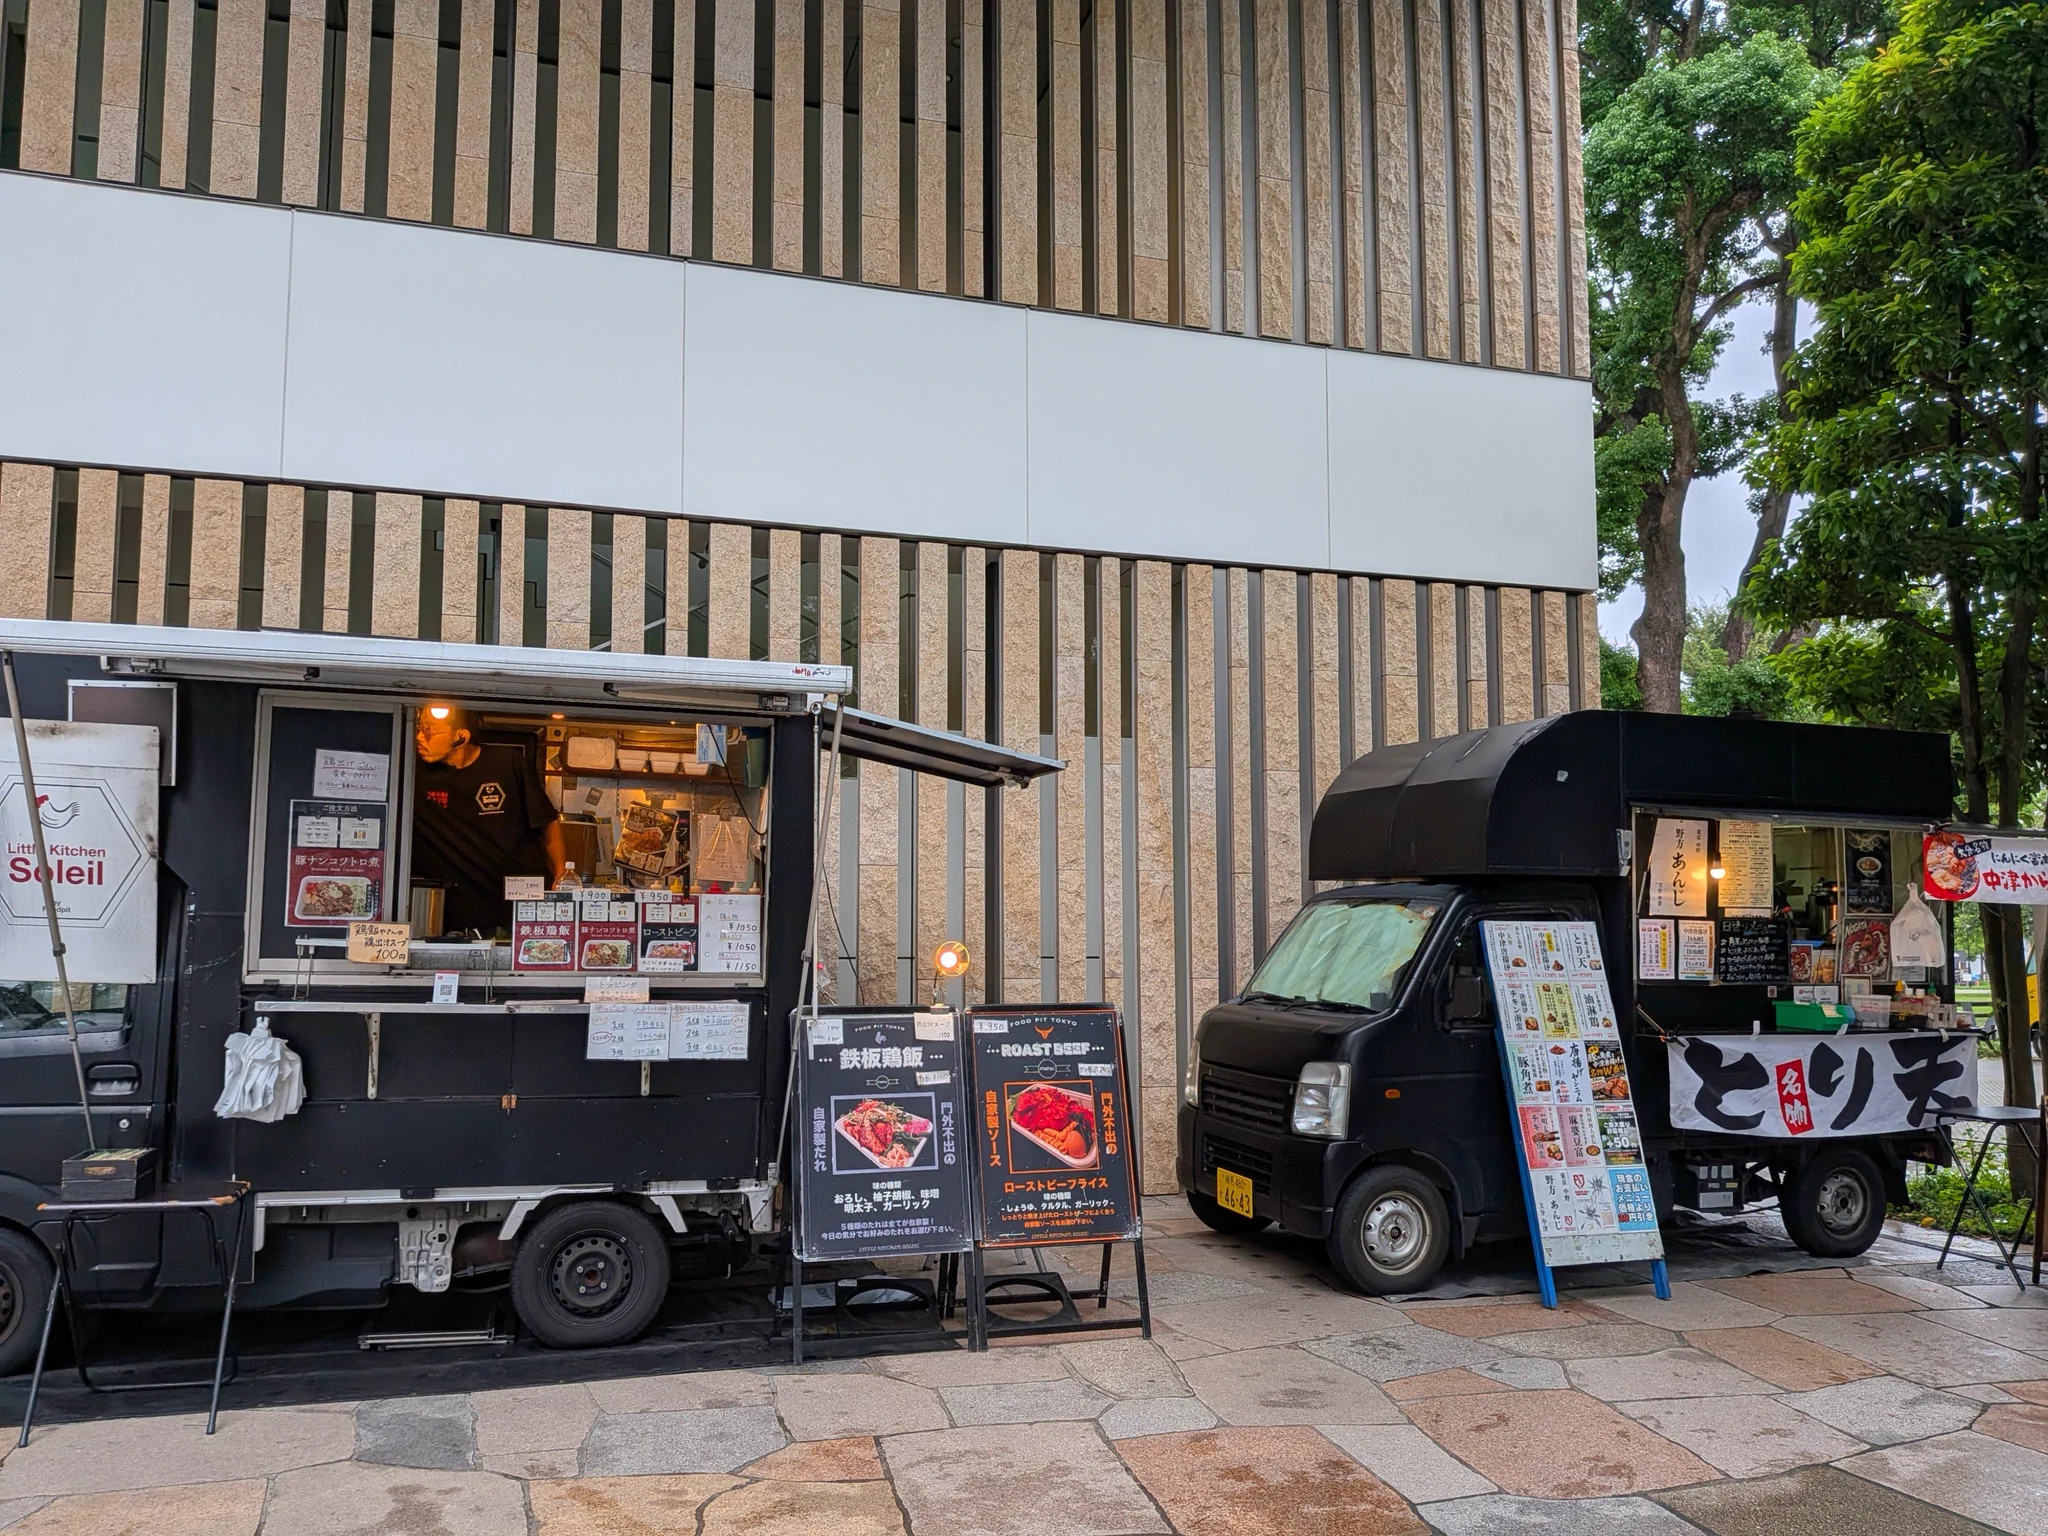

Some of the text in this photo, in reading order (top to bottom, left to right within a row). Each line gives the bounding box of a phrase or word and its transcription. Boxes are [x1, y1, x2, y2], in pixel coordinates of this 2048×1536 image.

[322, 804, 358, 812] ご注文方法
[7, 842, 106, 857] Littl Kitchen
[295, 855, 380, 867] 豚ナンコツトロ煮
[1672, 828, 1686, 907] 野方 あんじ
[9, 857, 104, 885] Soleil
[579, 890, 606, 900] ¥900
[640, 891, 668, 901] ¥950
[355, 924, 403, 936] 鶏飯やさんの
[520, 925, 570, 936] 鉄板鶏飯
[643, 928, 697, 938] ローストビーフ
[1845, 921, 1867, 937] NOGATA
[364, 937, 408, 948] 鶏出汁スープ
[375, 949, 406, 960] 100円
[1574, 933, 1588, 969] とり天
[1584, 993, 1599, 1028] 油淋鶏
[978, 1021, 1004, 1031] ¥950
[1010, 1019, 1031, 1027] FOOD
[1051, 1018, 1077, 1026] TOKYO
[686, 1029, 699, 1038] 2位
[686, 1043, 699, 1051] 3位
[1001, 1042, 1091, 1057] ROAST BEEF
[839, 1046, 924, 1070] 鉄板鶏飯
[1569, 1042, 1584, 1076] 唐揚げ
[1517, 1056, 1533, 1095] 豚角煮
[1684, 1036, 1972, 1130] とり天
[1571, 1073, 1583, 1103] ヤンニョム
[1781, 1067, 1808, 1127] 名物
[985, 1090, 1001, 1167] 自家製ソース
[1100, 1093, 1117, 1155] 門外不出の
[813, 1107, 827, 1172] 自家製だれ
[940, 1102, 956, 1165] 門外不出の
[872, 1181, 902, 1190] 味の種類
[1004, 1177, 1109, 1193] ローストビーフライス
[1615, 1173, 1642, 1183] 現金の
[1615, 1183, 1649, 1193] お支払い
[833, 1188, 940, 1204] おろし、柚子胡椒、味噌
[1043, 1192, 1072, 1200] 味の種類
[1224, 1186, 1250, 1214] 46-43
[1545, 1175, 1563, 1231] 野方 あんじ
[1618, 1194, 1650, 1202] メニュー
[843, 1199, 930, 1213] 明太子、ガーリック
[1618, 1203, 1651, 1213] 価格より
[821, 1225, 955, 1241] 今日の気分でお好みのたれをお選び下さい。
